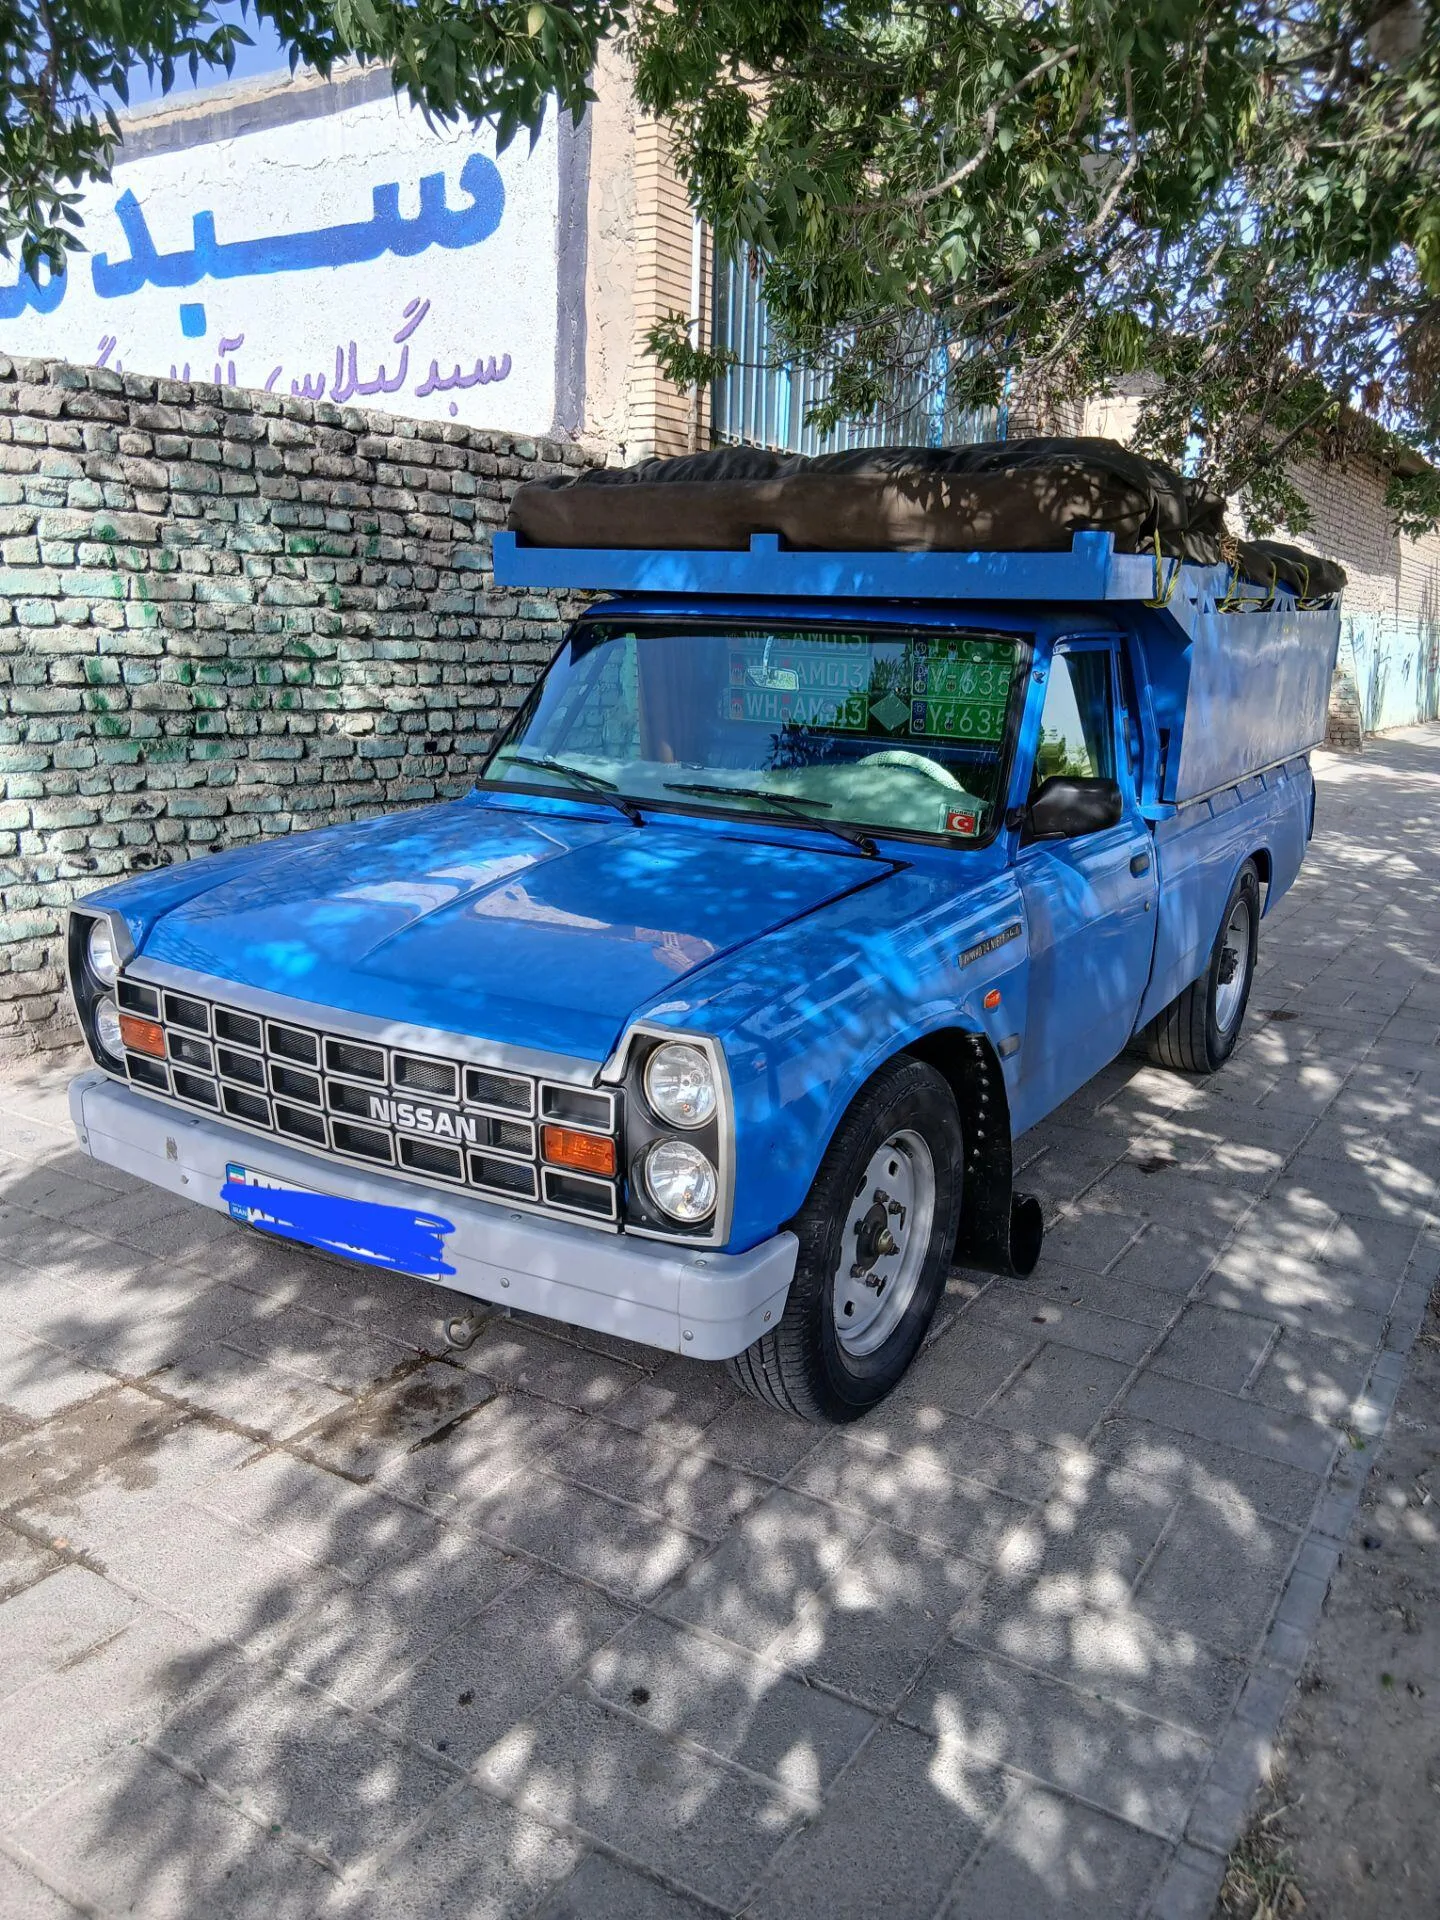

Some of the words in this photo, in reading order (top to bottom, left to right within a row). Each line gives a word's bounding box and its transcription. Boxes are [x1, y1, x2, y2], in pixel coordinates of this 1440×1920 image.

[92, 153, 505, 338] سبد
[415, 353, 512, 417] سبد
[369, 1095, 477, 1142] NISSAN
